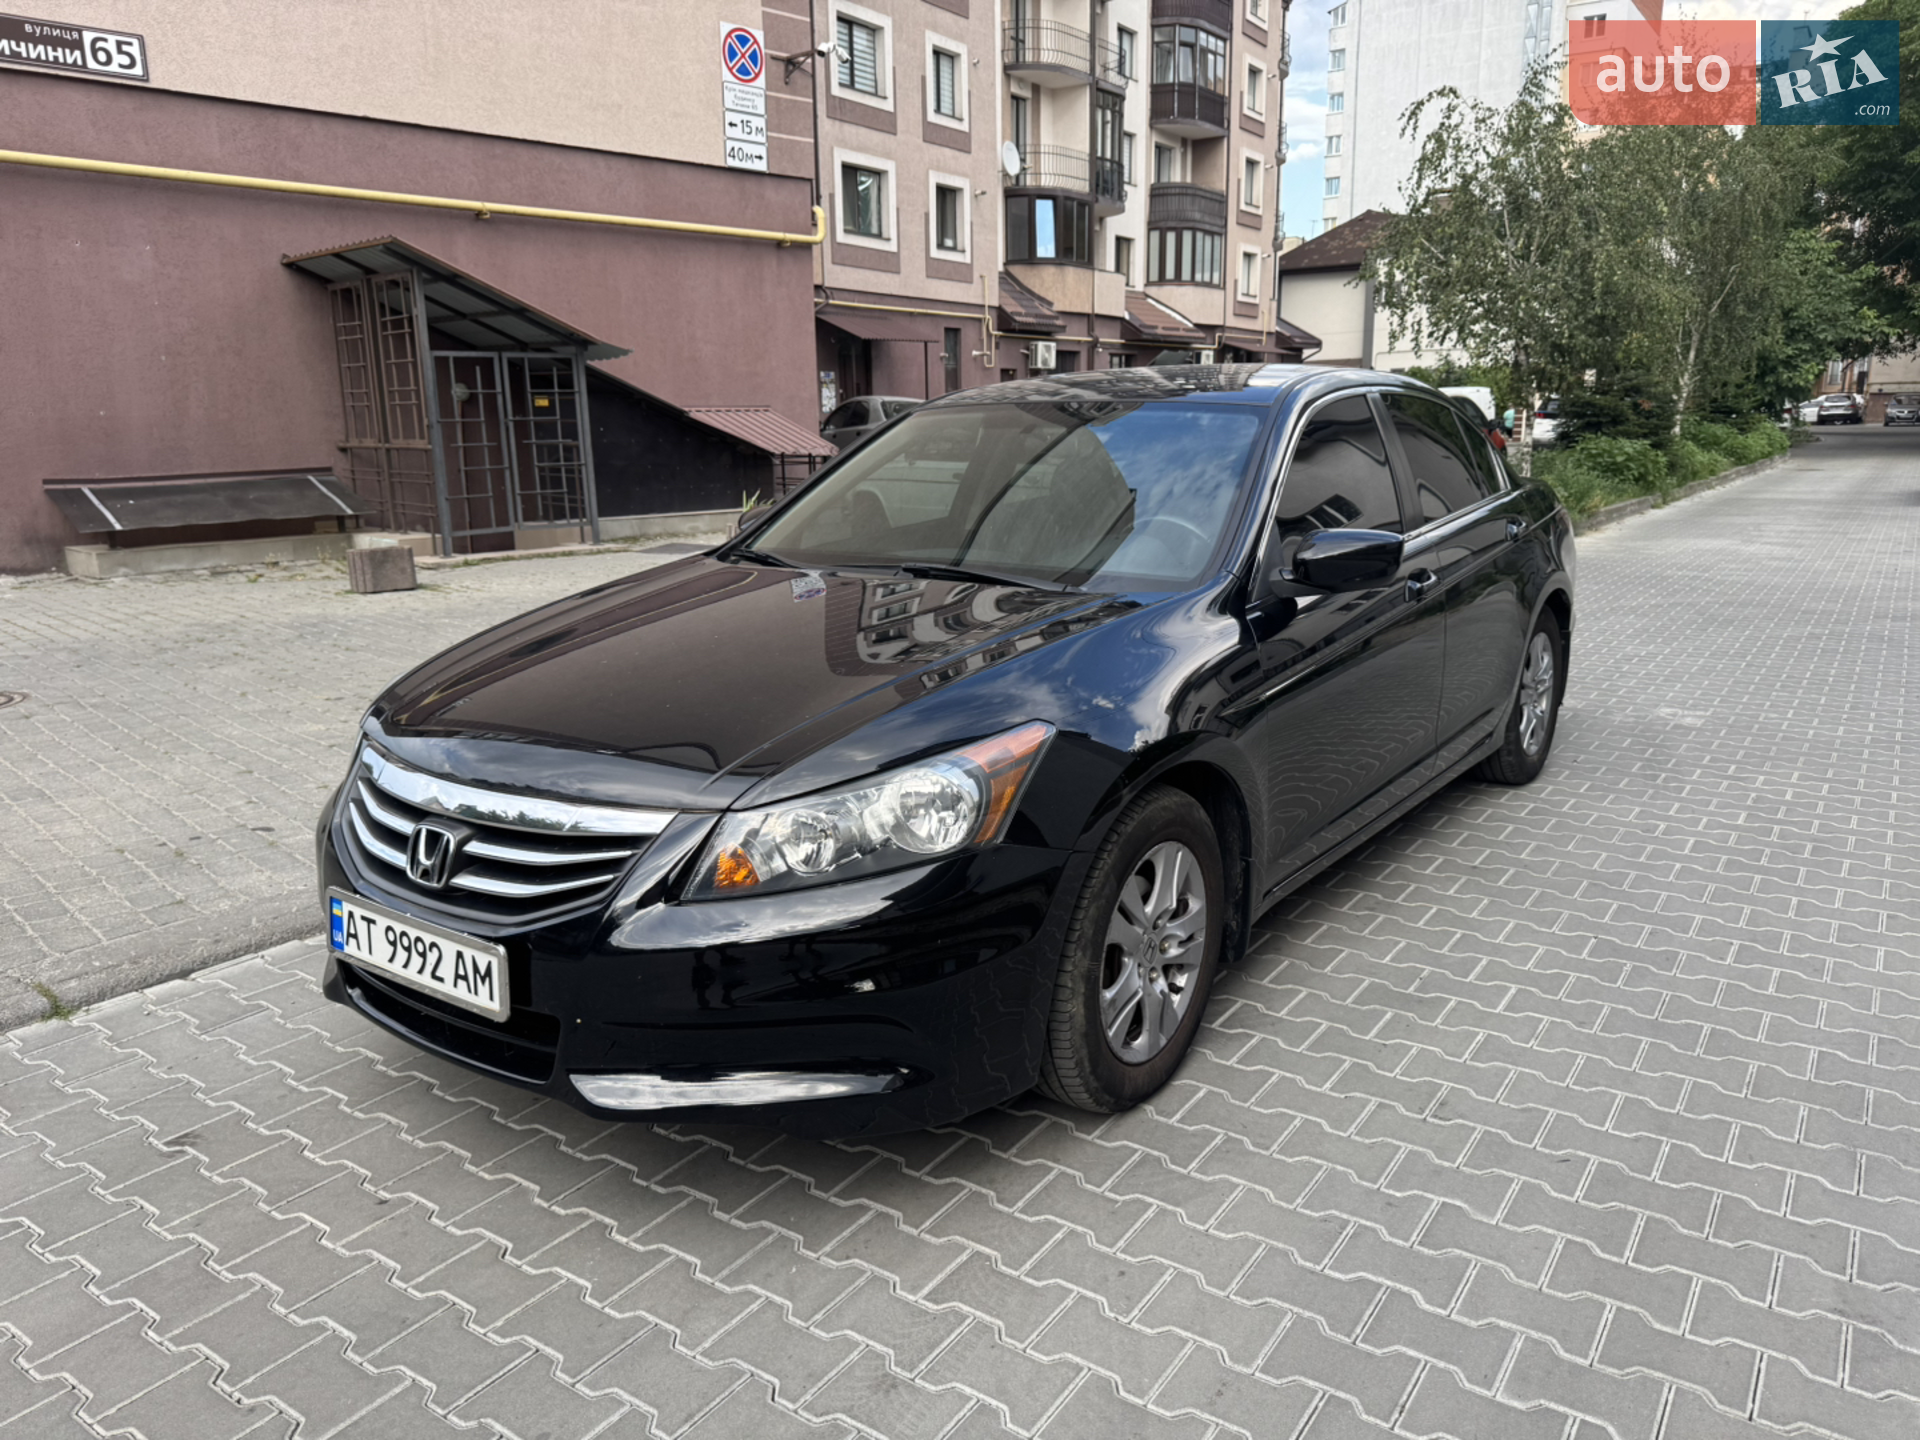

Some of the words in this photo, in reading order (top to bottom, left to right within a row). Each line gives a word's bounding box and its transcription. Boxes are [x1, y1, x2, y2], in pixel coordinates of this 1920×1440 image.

[24, 23, 80, 40] вулиця
[90, 36, 137, 70] 65
[740, 119, 753, 136] 15
[332, 928, 344, 945] UA
[345, 909, 378, 957] AT
[384, 924, 446, 984] 9992
[453, 949, 495, 1002] AM
